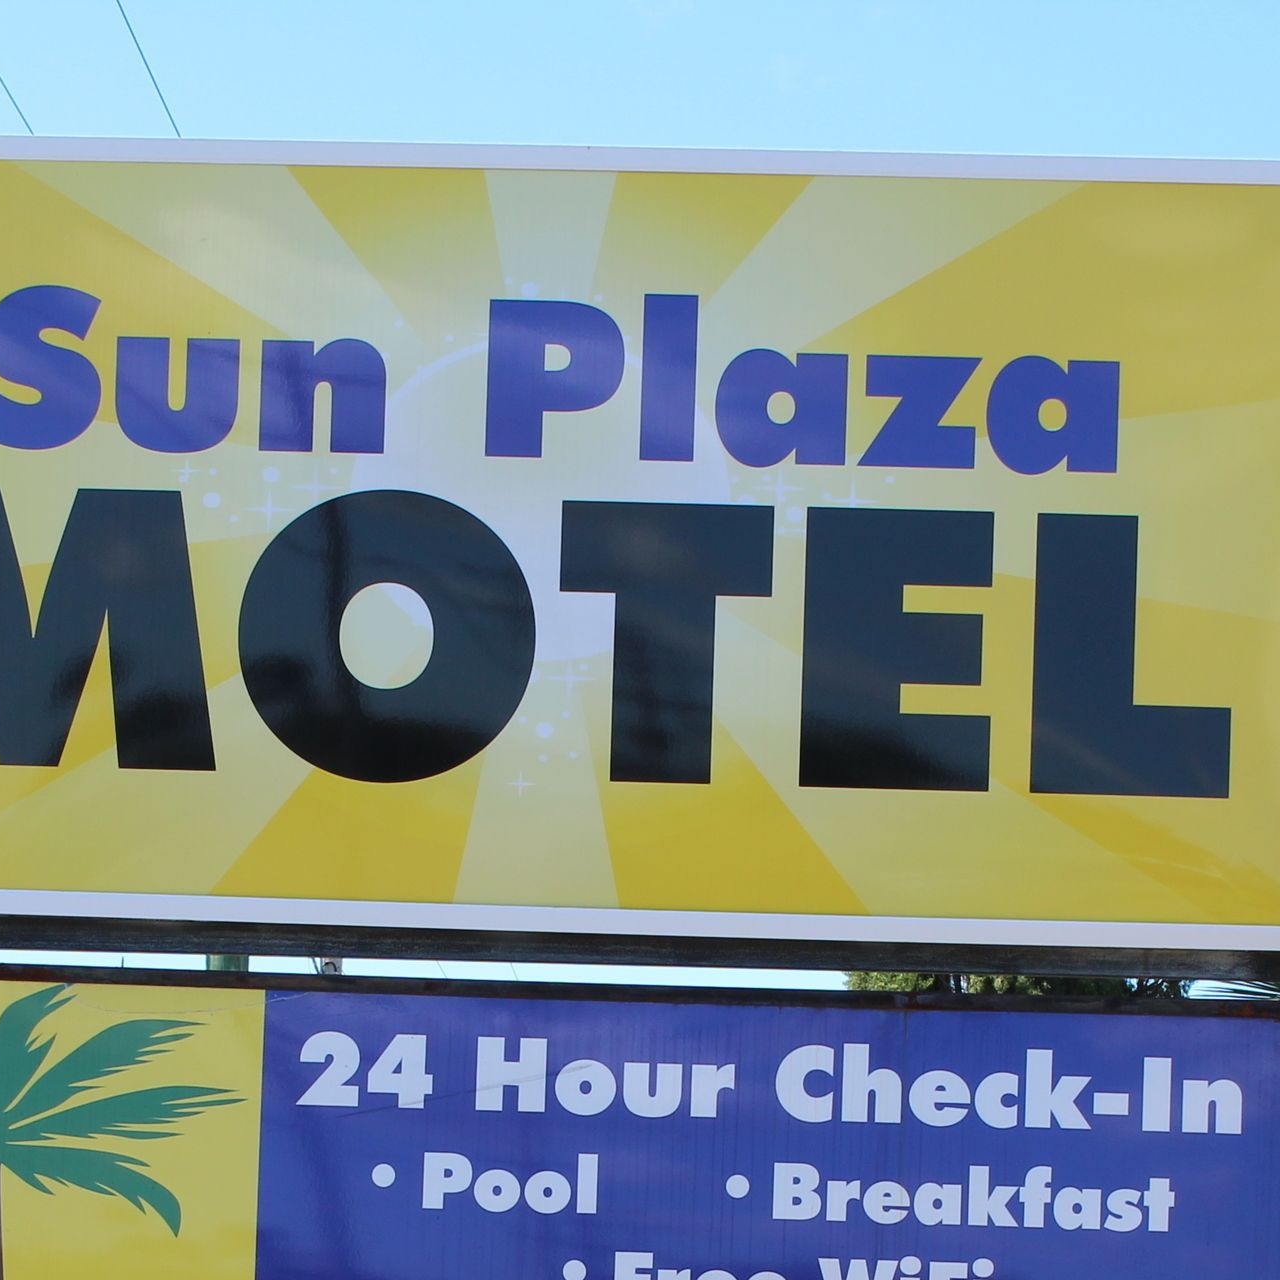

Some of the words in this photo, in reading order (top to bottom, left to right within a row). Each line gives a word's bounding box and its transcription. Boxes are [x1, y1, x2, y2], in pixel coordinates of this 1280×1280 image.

[485, 294, 1121, 476] Plaza
[296, 1031, 433, 1109] 24
[475, 1036, 735, 1118] Hour
[775, 1043, 1243, 1135] Check-In
[422, 1151, 599, 1215] Pool
[773, 1162, 1175, 1233] Breakfast
